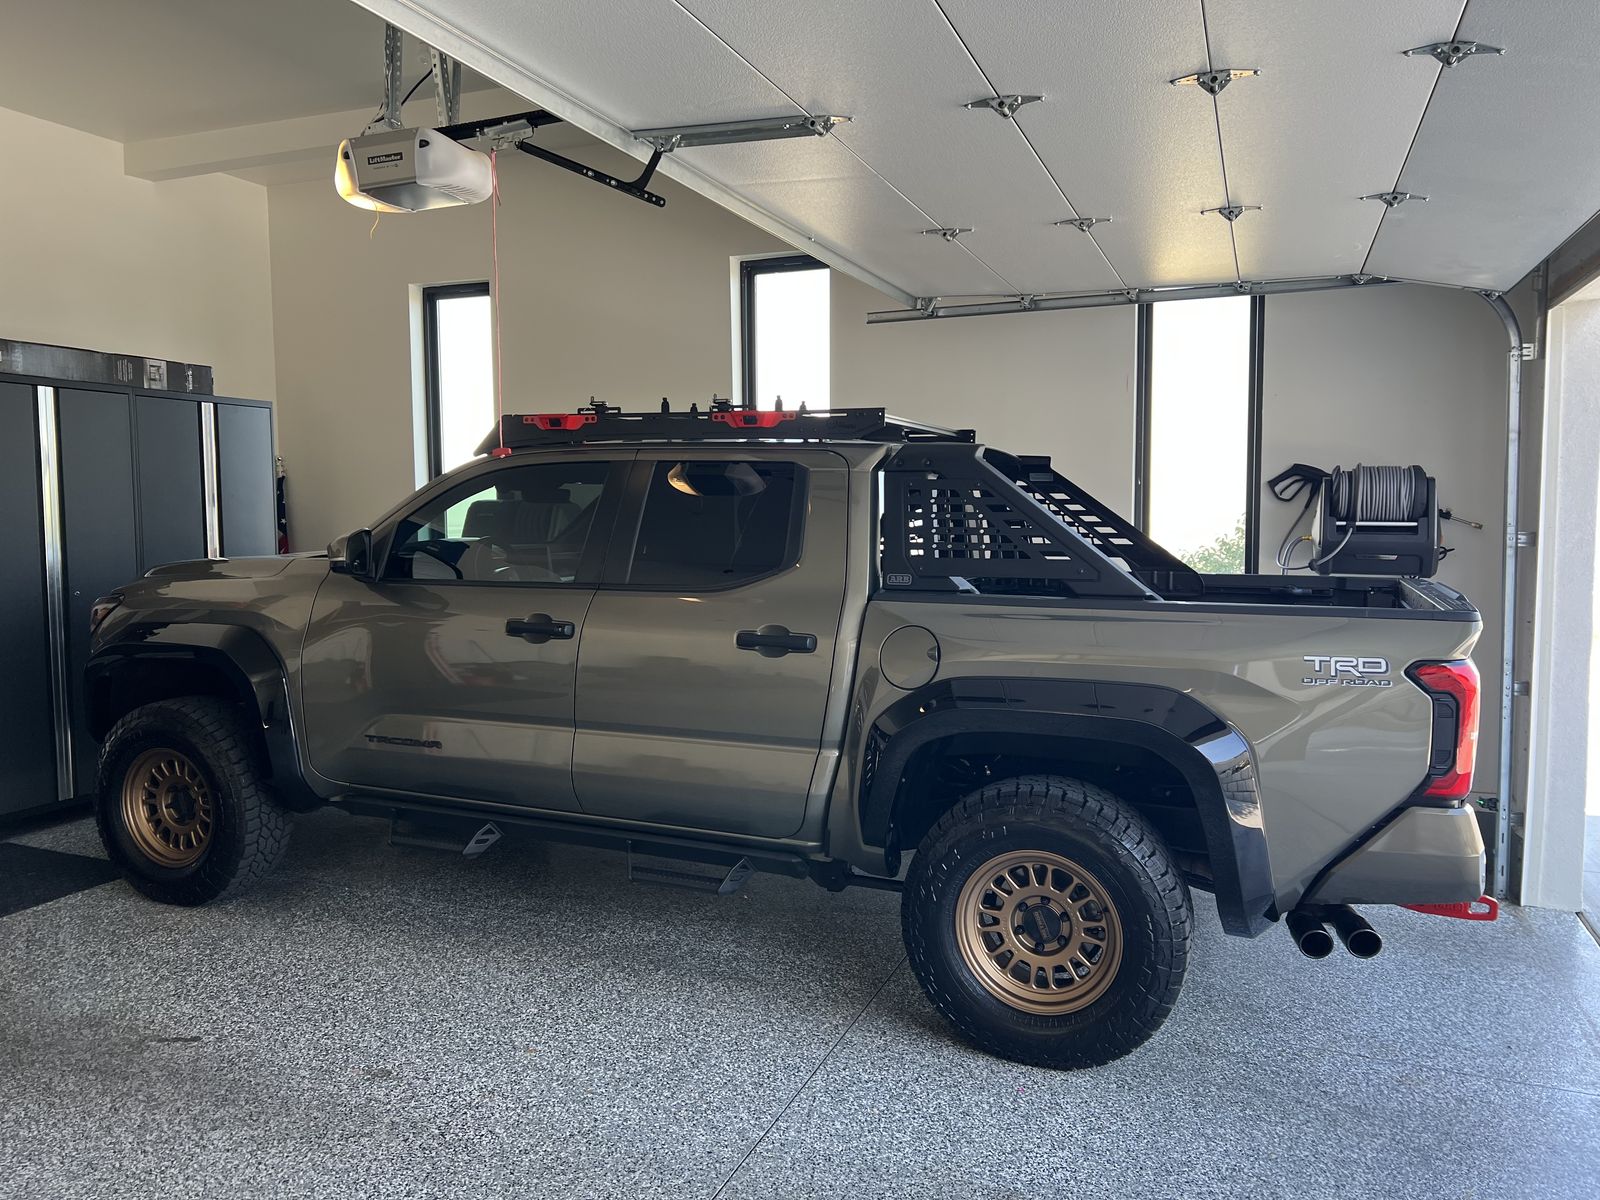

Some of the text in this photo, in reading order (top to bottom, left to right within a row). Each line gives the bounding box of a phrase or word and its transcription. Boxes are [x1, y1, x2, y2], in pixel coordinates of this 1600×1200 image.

[1303, 655, 1389, 678] TRD
[1302, 678, 1393, 688] OFF ROAD
